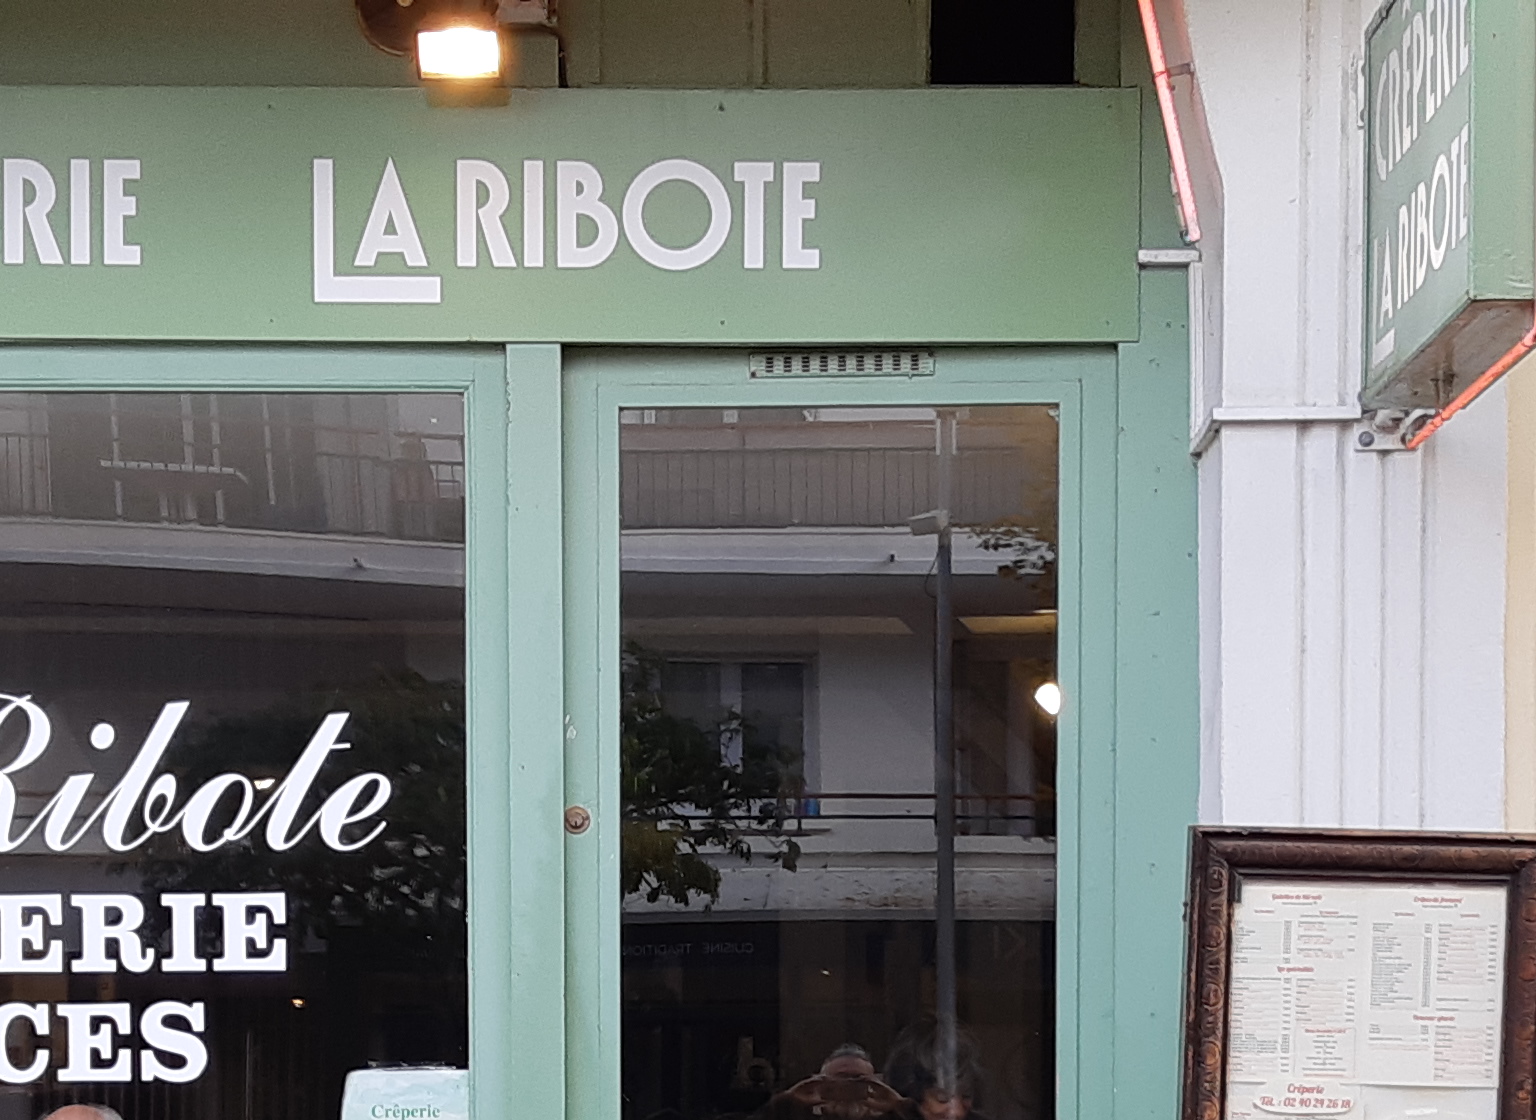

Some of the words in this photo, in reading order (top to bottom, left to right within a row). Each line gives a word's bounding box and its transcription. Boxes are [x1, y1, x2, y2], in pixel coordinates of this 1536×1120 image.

[311, 155, 443, 305] LA
[454, 156, 823, 272] RIBOTE
[1372, 227, 1396, 368] LA
[1396, 122, 1470, 311] RIBOTE
